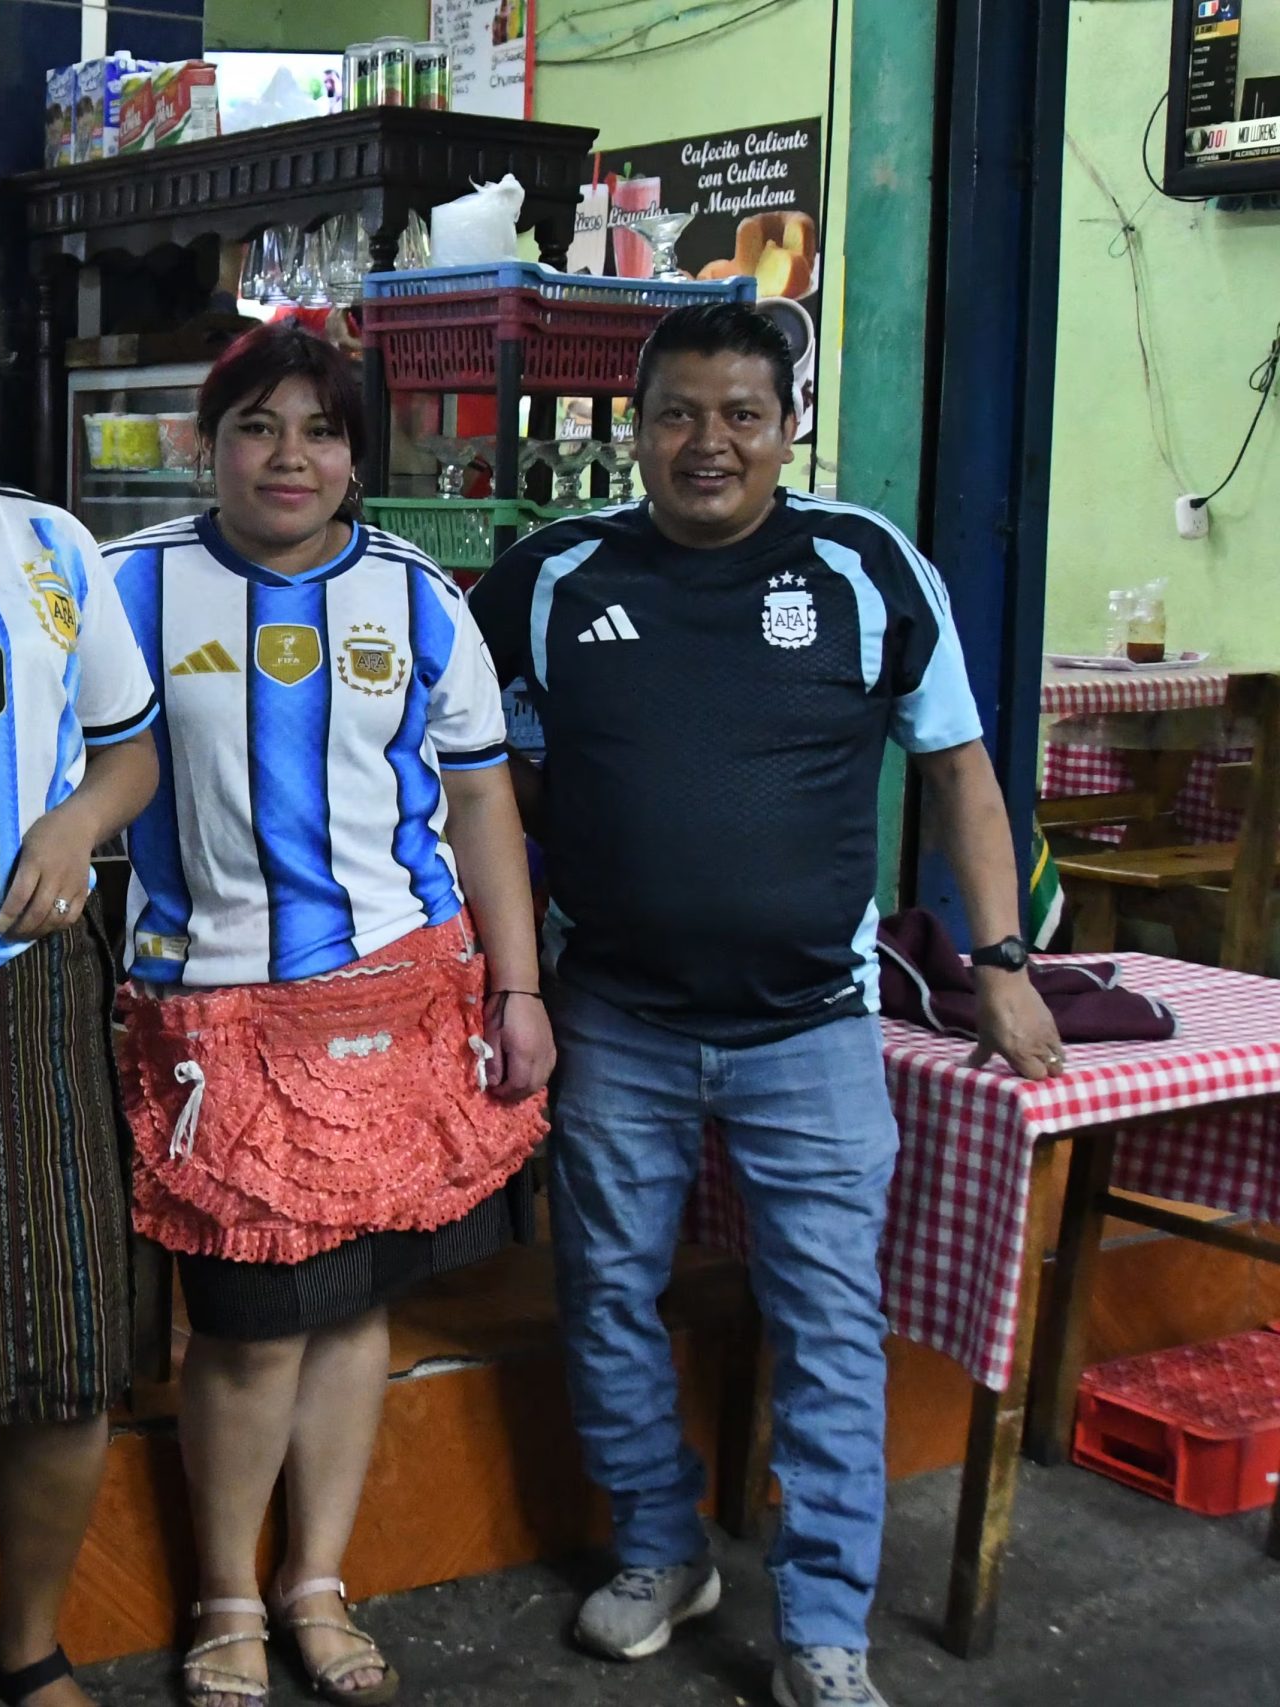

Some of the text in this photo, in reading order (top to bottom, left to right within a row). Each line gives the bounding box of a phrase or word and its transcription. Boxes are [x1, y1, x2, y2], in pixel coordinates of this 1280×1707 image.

[681, 129, 808, 168] Cafecito Caliente
[698, 159, 788, 189] con Cubilete
[691, 185, 796, 216] o Magdalena
[54, 592, 75, 629] AFA
[774, 605, 806, 631] AFA
[356, 651, 387, 673] AFA
